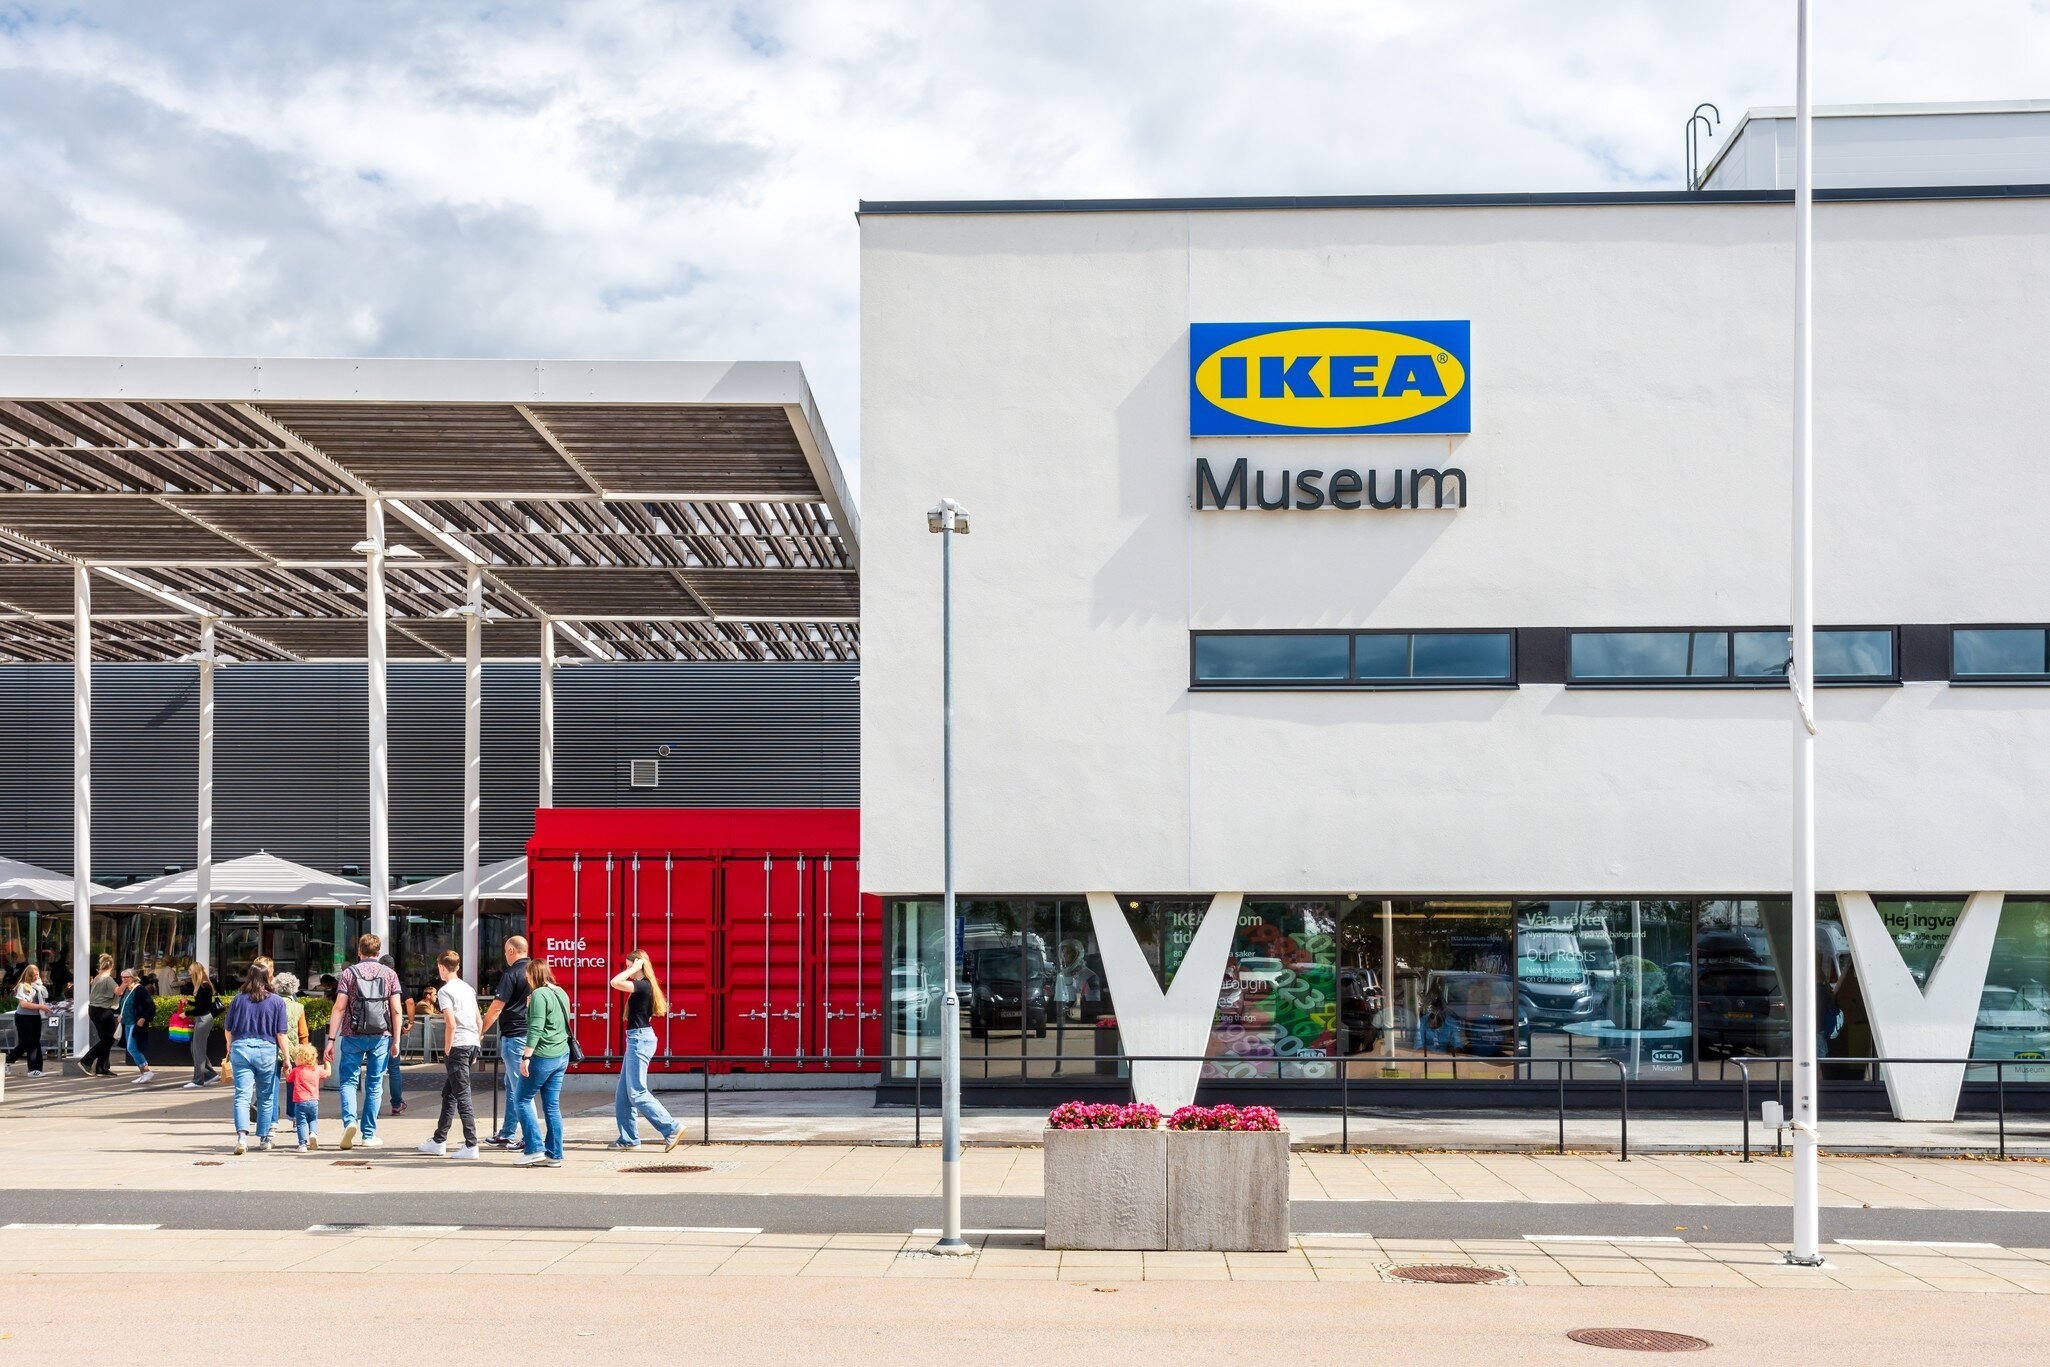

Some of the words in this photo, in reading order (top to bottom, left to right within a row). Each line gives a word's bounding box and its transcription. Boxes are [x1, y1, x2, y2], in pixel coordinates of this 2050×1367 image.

[1195, 457, 1467, 511] Museum
[1526, 911, 1559, 926] Våra
[1563, 912, 1608, 926] rötter
[1884, 913, 1909, 930] Hej
[1526, 931, 1542, 940] Nya
[547, 937, 586, 951] Entré
[546, 954, 605, 968] Entrance
[1235, 950, 1256, 958] saker
[1526, 948, 1551, 962] Our
[1557, 948, 1597, 962] Roots
